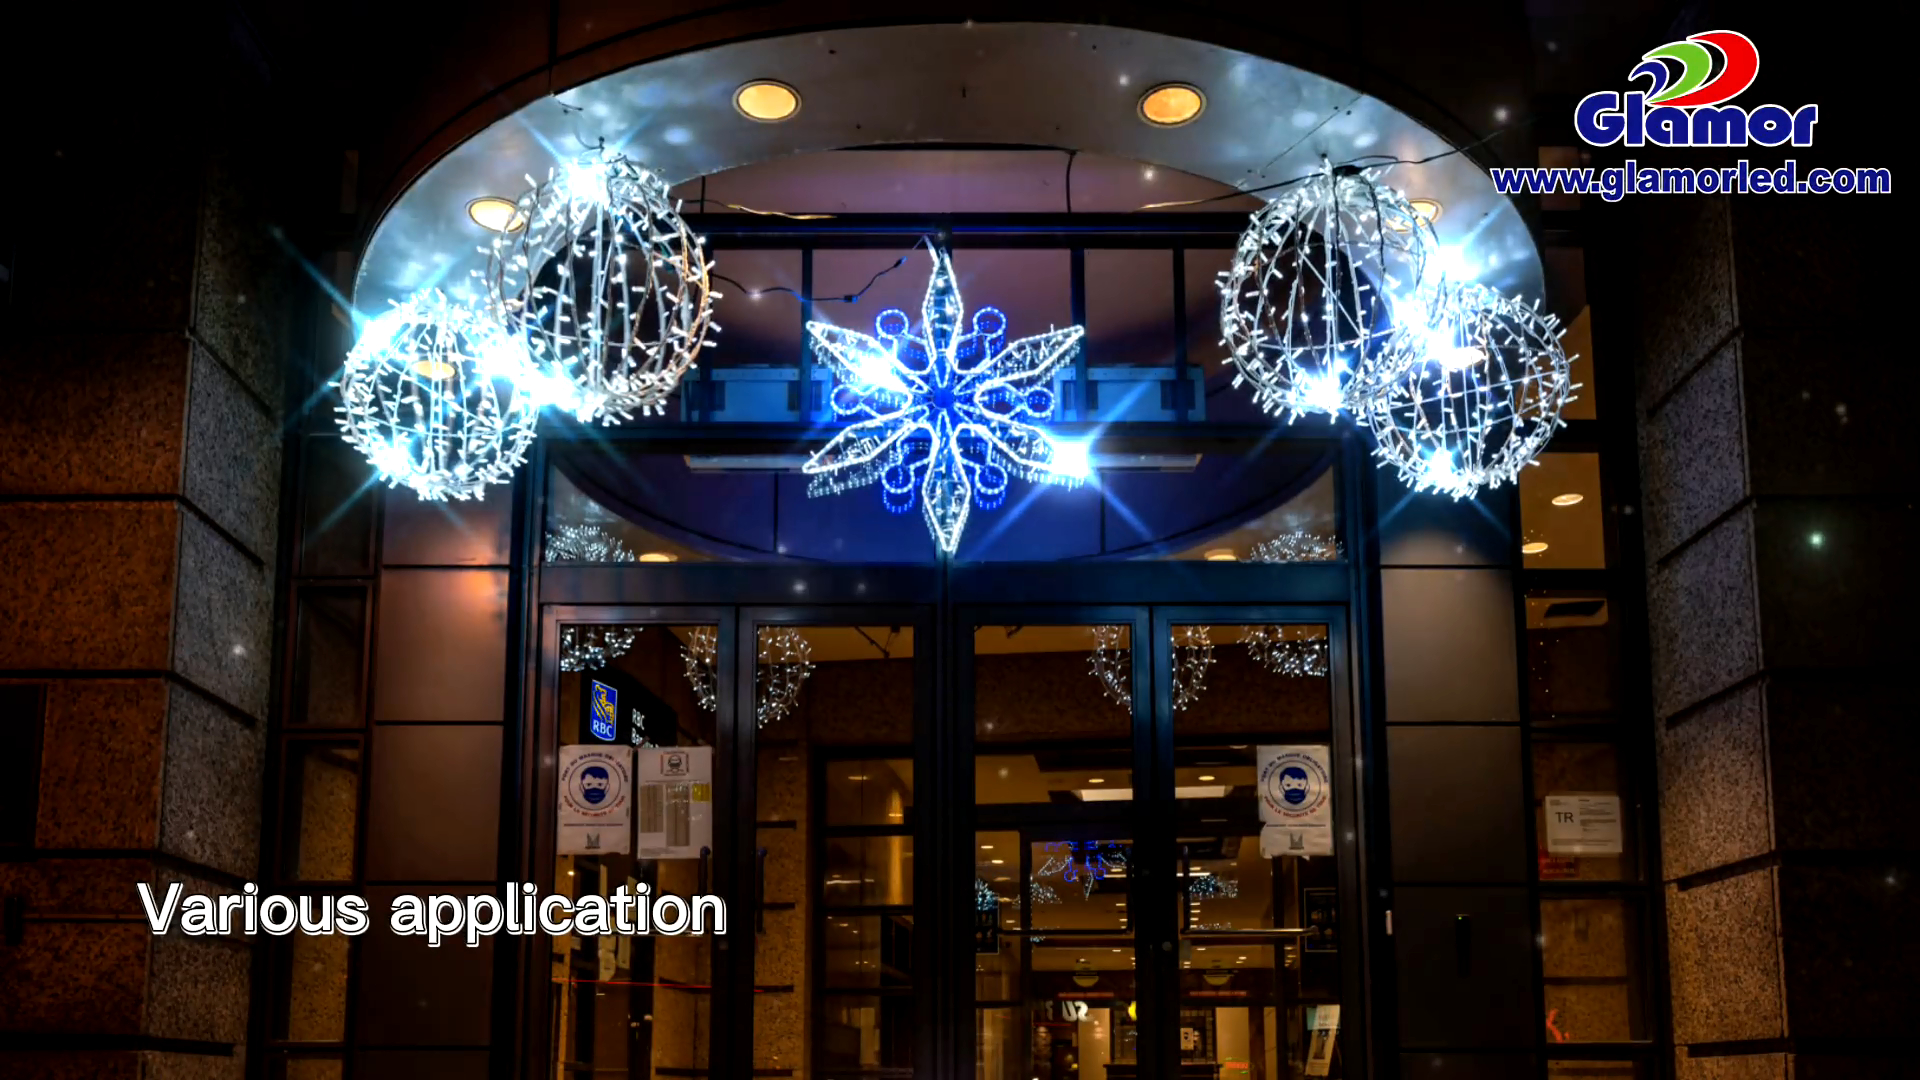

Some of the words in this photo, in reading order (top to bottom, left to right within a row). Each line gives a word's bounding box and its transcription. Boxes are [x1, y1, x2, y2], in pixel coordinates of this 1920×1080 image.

[593, 719, 613, 738] RBC
[632, 708, 645, 731] RBC
[1555, 811, 1574, 823] TR
